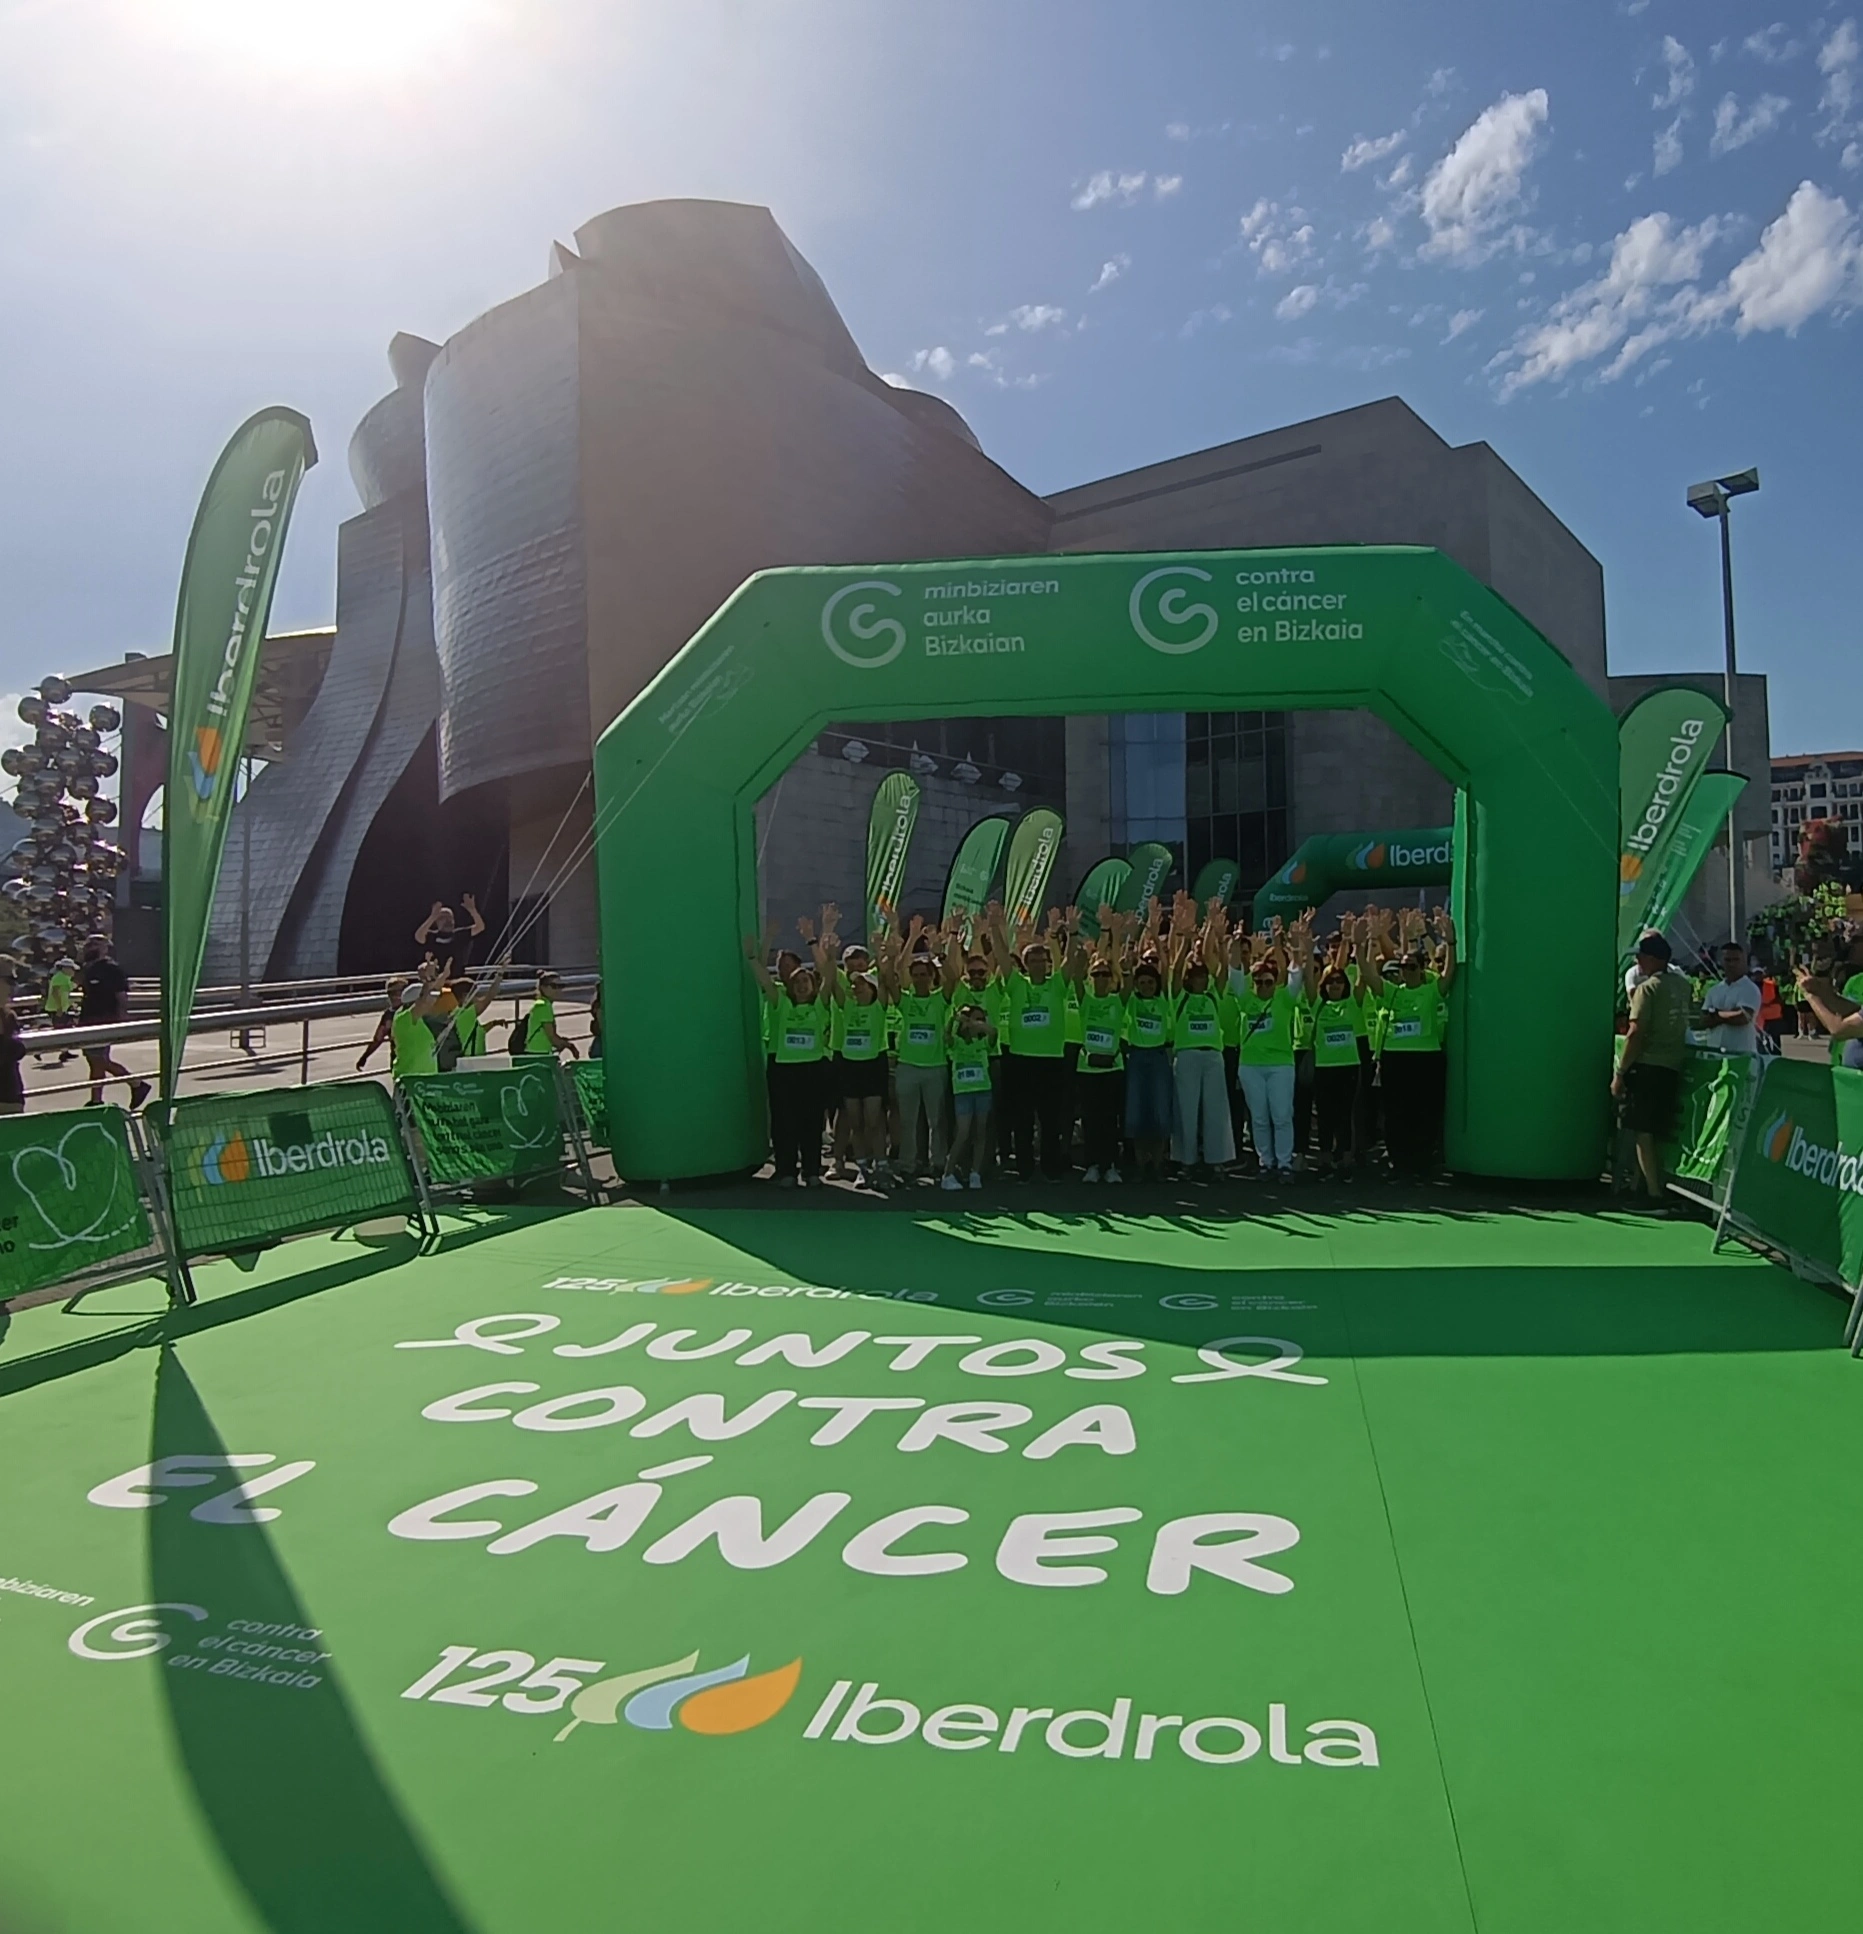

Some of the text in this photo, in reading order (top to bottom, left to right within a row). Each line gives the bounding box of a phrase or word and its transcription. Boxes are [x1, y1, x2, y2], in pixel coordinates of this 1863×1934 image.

[924, 579, 1060, 599] minbiziaren
[1235, 568, 1315, 585] contra
[1236, 590, 1348, 613] el cáncer
[923, 605, 991, 627] aurka
[1237, 618, 1364, 643] en Bizkaia
[924, 633, 1026, 657] Bizkaian
[1627, 719, 1704, 852] Iberdrola
[1390, 841, 1453, 867] Iberd
[1134, 858, 1164, 919] berdrola
[253, 1129, 390, 1178] Iberdrola
[541, 1277, 939, 1302] 125 Iberdrola
[552, 1323, 1147, 1380] JUNTOS
[421, 1381, 1137, 1459] CONTRA
[87, 1453, 1301, 1595] EL CÁNCER
[227, 1618, 323, 1642] contra
[198, 1635, 332, 1666] el cáncer
[167, 1654, 322, 1689] en Bizkaia
[400, 1645, 1380, 1769] 125 Iberdrola
